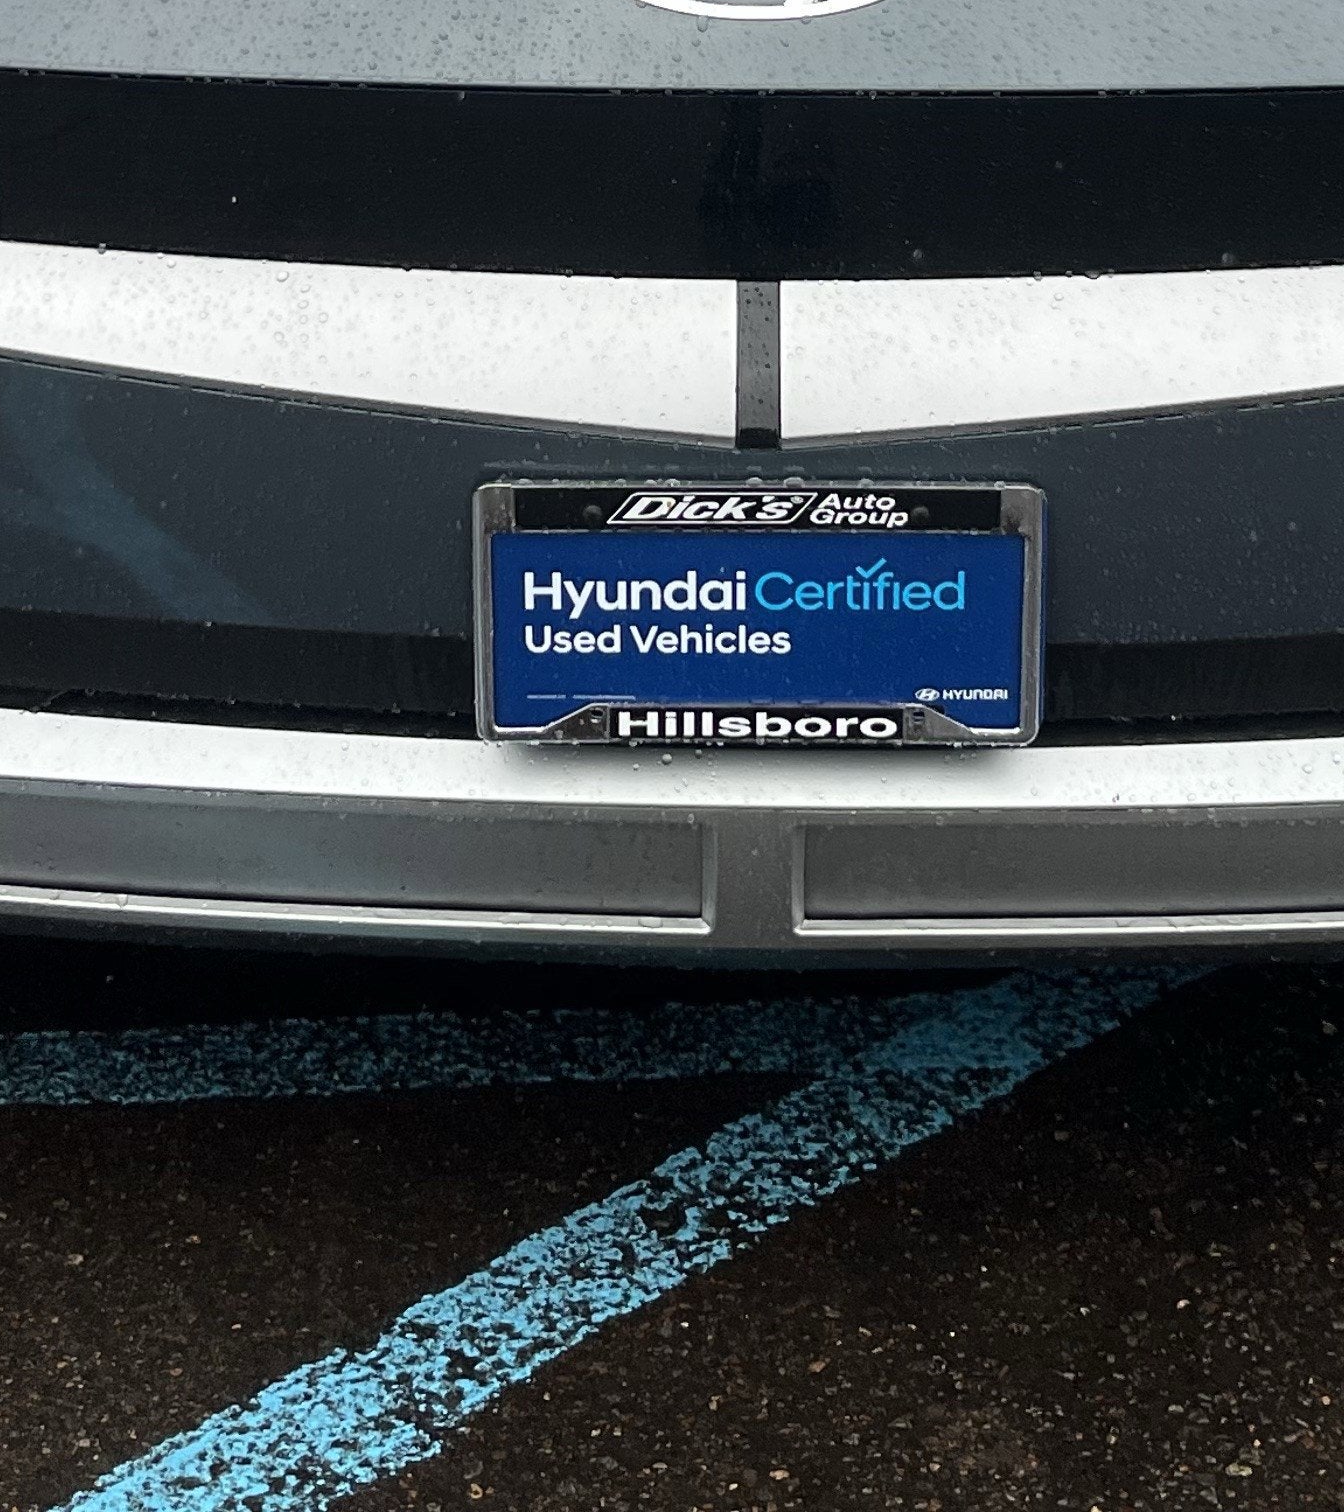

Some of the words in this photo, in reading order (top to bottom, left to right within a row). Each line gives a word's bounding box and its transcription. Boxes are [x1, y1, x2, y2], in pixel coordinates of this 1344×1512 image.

[817, 493, 896, 510] Auto
[809, 509, 909, 528] Group
[524, 571, 747, 619] Hyundai
[755, 559, 966, 610] Certified
[525, 625, 622, 654] Used
[629, 624, 792, 654] Vehicles
[942, 689, 1009, 700] HYUNDAI
[618, 711, 898, 738] Hillsboro
